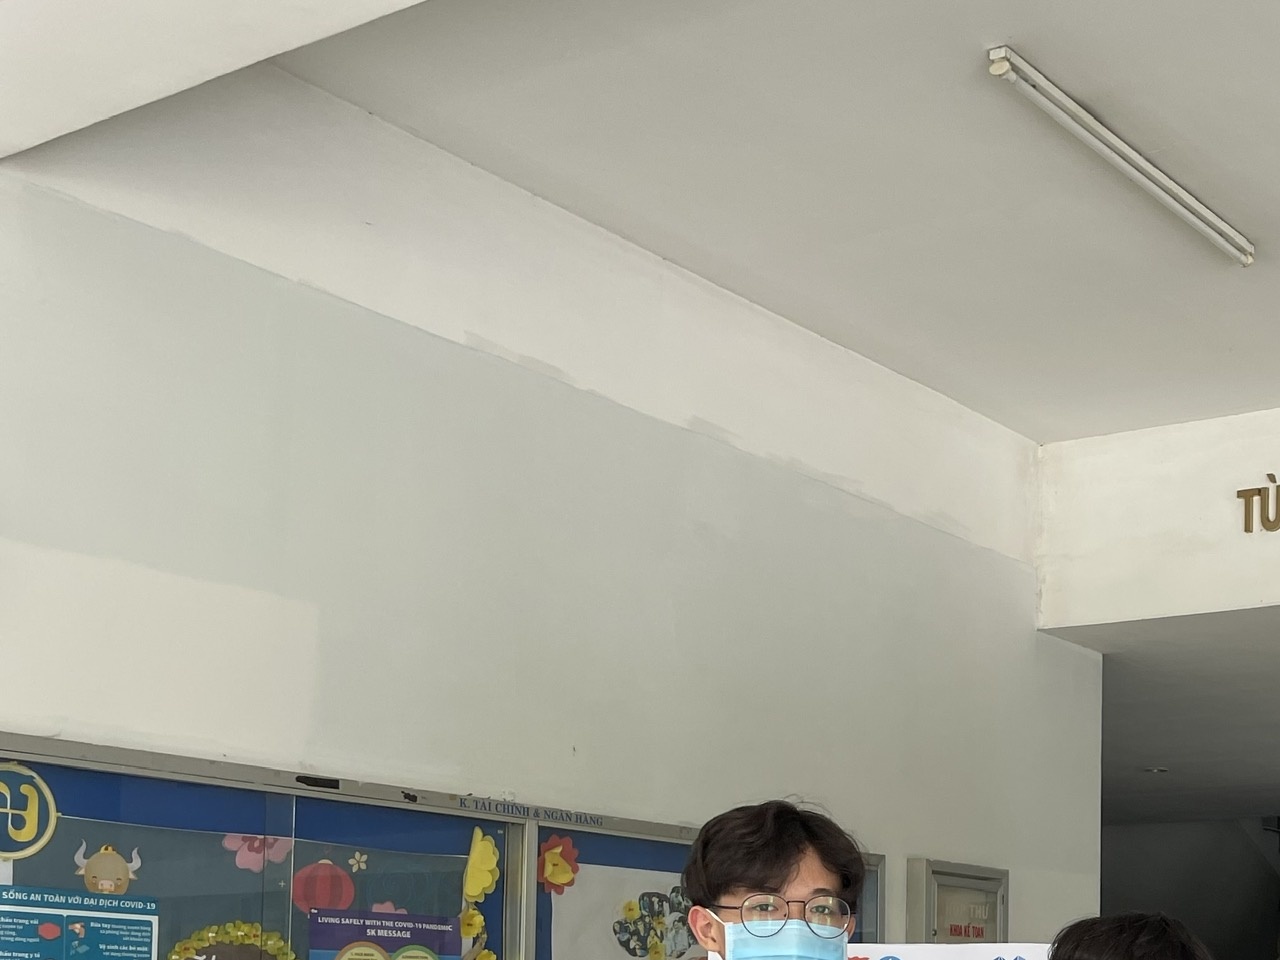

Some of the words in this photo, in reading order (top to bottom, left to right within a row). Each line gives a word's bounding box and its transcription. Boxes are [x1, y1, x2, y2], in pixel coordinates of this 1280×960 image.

[533, 808, 540, 818] &
[2, 890, 28, 900] SỐNG
[44, 894, 66, 903] TOÀN
[120, 901, 156, 910] COVID-19
[318, 916, 341, 924] LIVING
[342, 918, 364, 926] SAFELY
[378, 930, 411, 938] MESSAGE
[950, 923, 963, 937] KHOA
